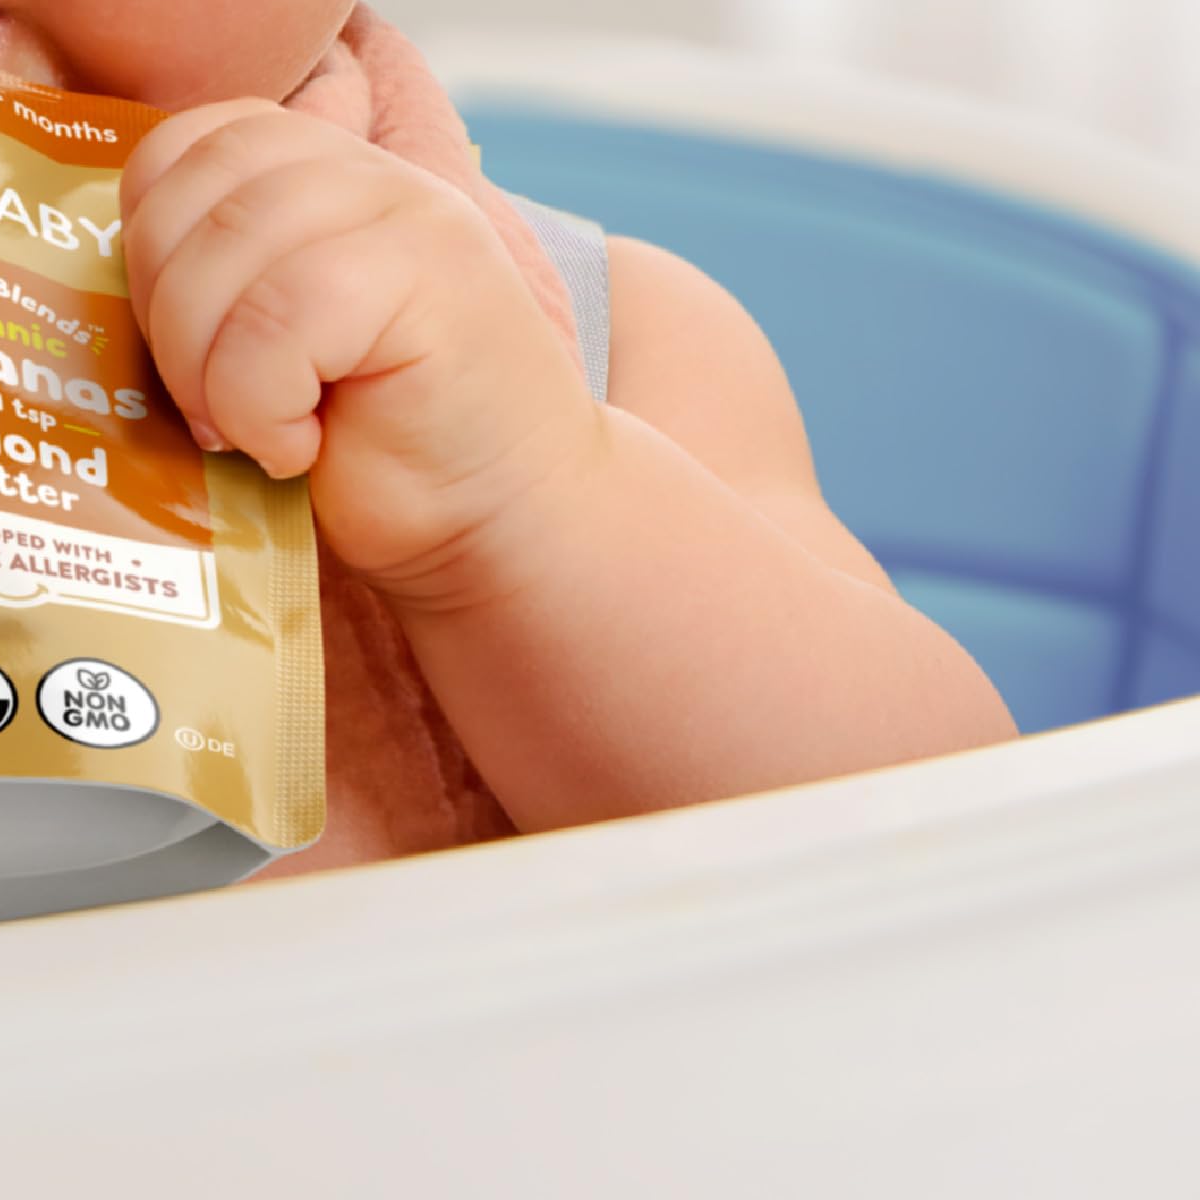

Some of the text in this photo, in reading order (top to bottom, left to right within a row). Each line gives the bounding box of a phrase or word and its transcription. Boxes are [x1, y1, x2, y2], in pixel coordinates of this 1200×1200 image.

[13, 100, 118, 144] months
[12, 398, 57, 432] tsp
[52, 539, 113, 565] WITH
[9, 553, 180, 599] ALLERGISTS
[63, 689, 128, 714] NON
[62, 708, 132, 733] GMO
[207, 738, 236, 759] DE
